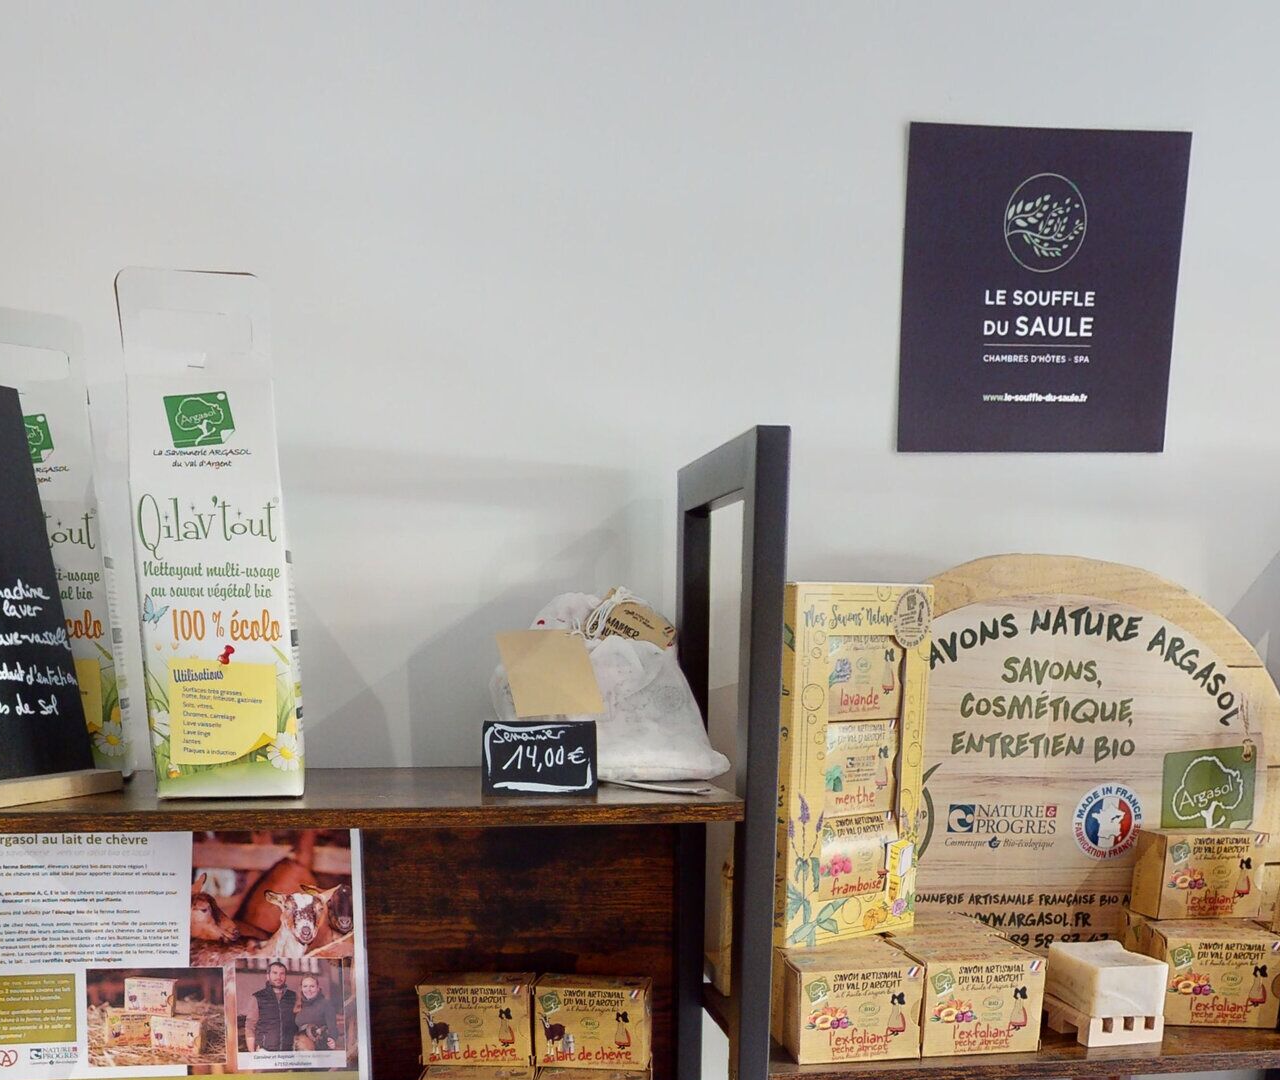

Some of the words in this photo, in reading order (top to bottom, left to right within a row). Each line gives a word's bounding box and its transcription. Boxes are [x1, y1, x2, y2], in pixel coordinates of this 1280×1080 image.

[985, 289, 1007, 306] LE
[1013, 290, 1096, 307] SOUFFLE
[983, 320, 1009, 336] DU
[1015, 316, 1094, 338] SAULE
[983, 354, 1028, 363] CHAMBRES
[1030, 352, 1066, 364] D'HÔTES
[1073, 355, 1090, 364] SPA
[983, 393, 1088, 403] www.le-souffle-du-saule.fr
[179, 407, 217, 426] Argasol
[207, 447, 251, 456] ARGASOL
[143, 561, 203, 580] Nettoyant
[206, 562, 280, 580] multi-usage
[151, 587, 166, 598] au
[169, 587, 205, 598] savon
[207, 583, 252, 601] végétal
[254, 584, 272, 598] bio
[3, 601, 42, 617] laver
[172, 609, 205, 641] 100
[230, 607, 283, 641] écolo
[173, 668, 224, 683] Utilisations
[1001, 656, 1102, 688] SAVONS,
[1030, 606, 1143, 642] NATURE
[1147, 626, 1240, 727] ARGASOL
[15, 697, 35, 715] de
[840, 688, 880, 707] lavande
[951, 731, 1084, 761] ENTRETIEN
[1094, 736, 1135, 763] BIO
[835, 790, 875, 805] menthe
[1077, 791, 1099, 819] MADE
[1102, 786, 1113, 796] IN
[1115, 787, 1141, 820] FRANCE
[1178, 777, 1234, 812] Argasol
[978, 804, 1044, 818] NATURE
[42, 836, 58, 845] au
[62, 833, 83, 845] lait
[87, 834, 102, 845] de
[106, 833, 148, 845] chèvre
[830, 877, 883, 896] framboise
[968, 893, 1034, 905] ARTISANALE
[1039, 893, 1096, 907] FRANÇAISE
[1099, 893, 1118, 905] BIO
